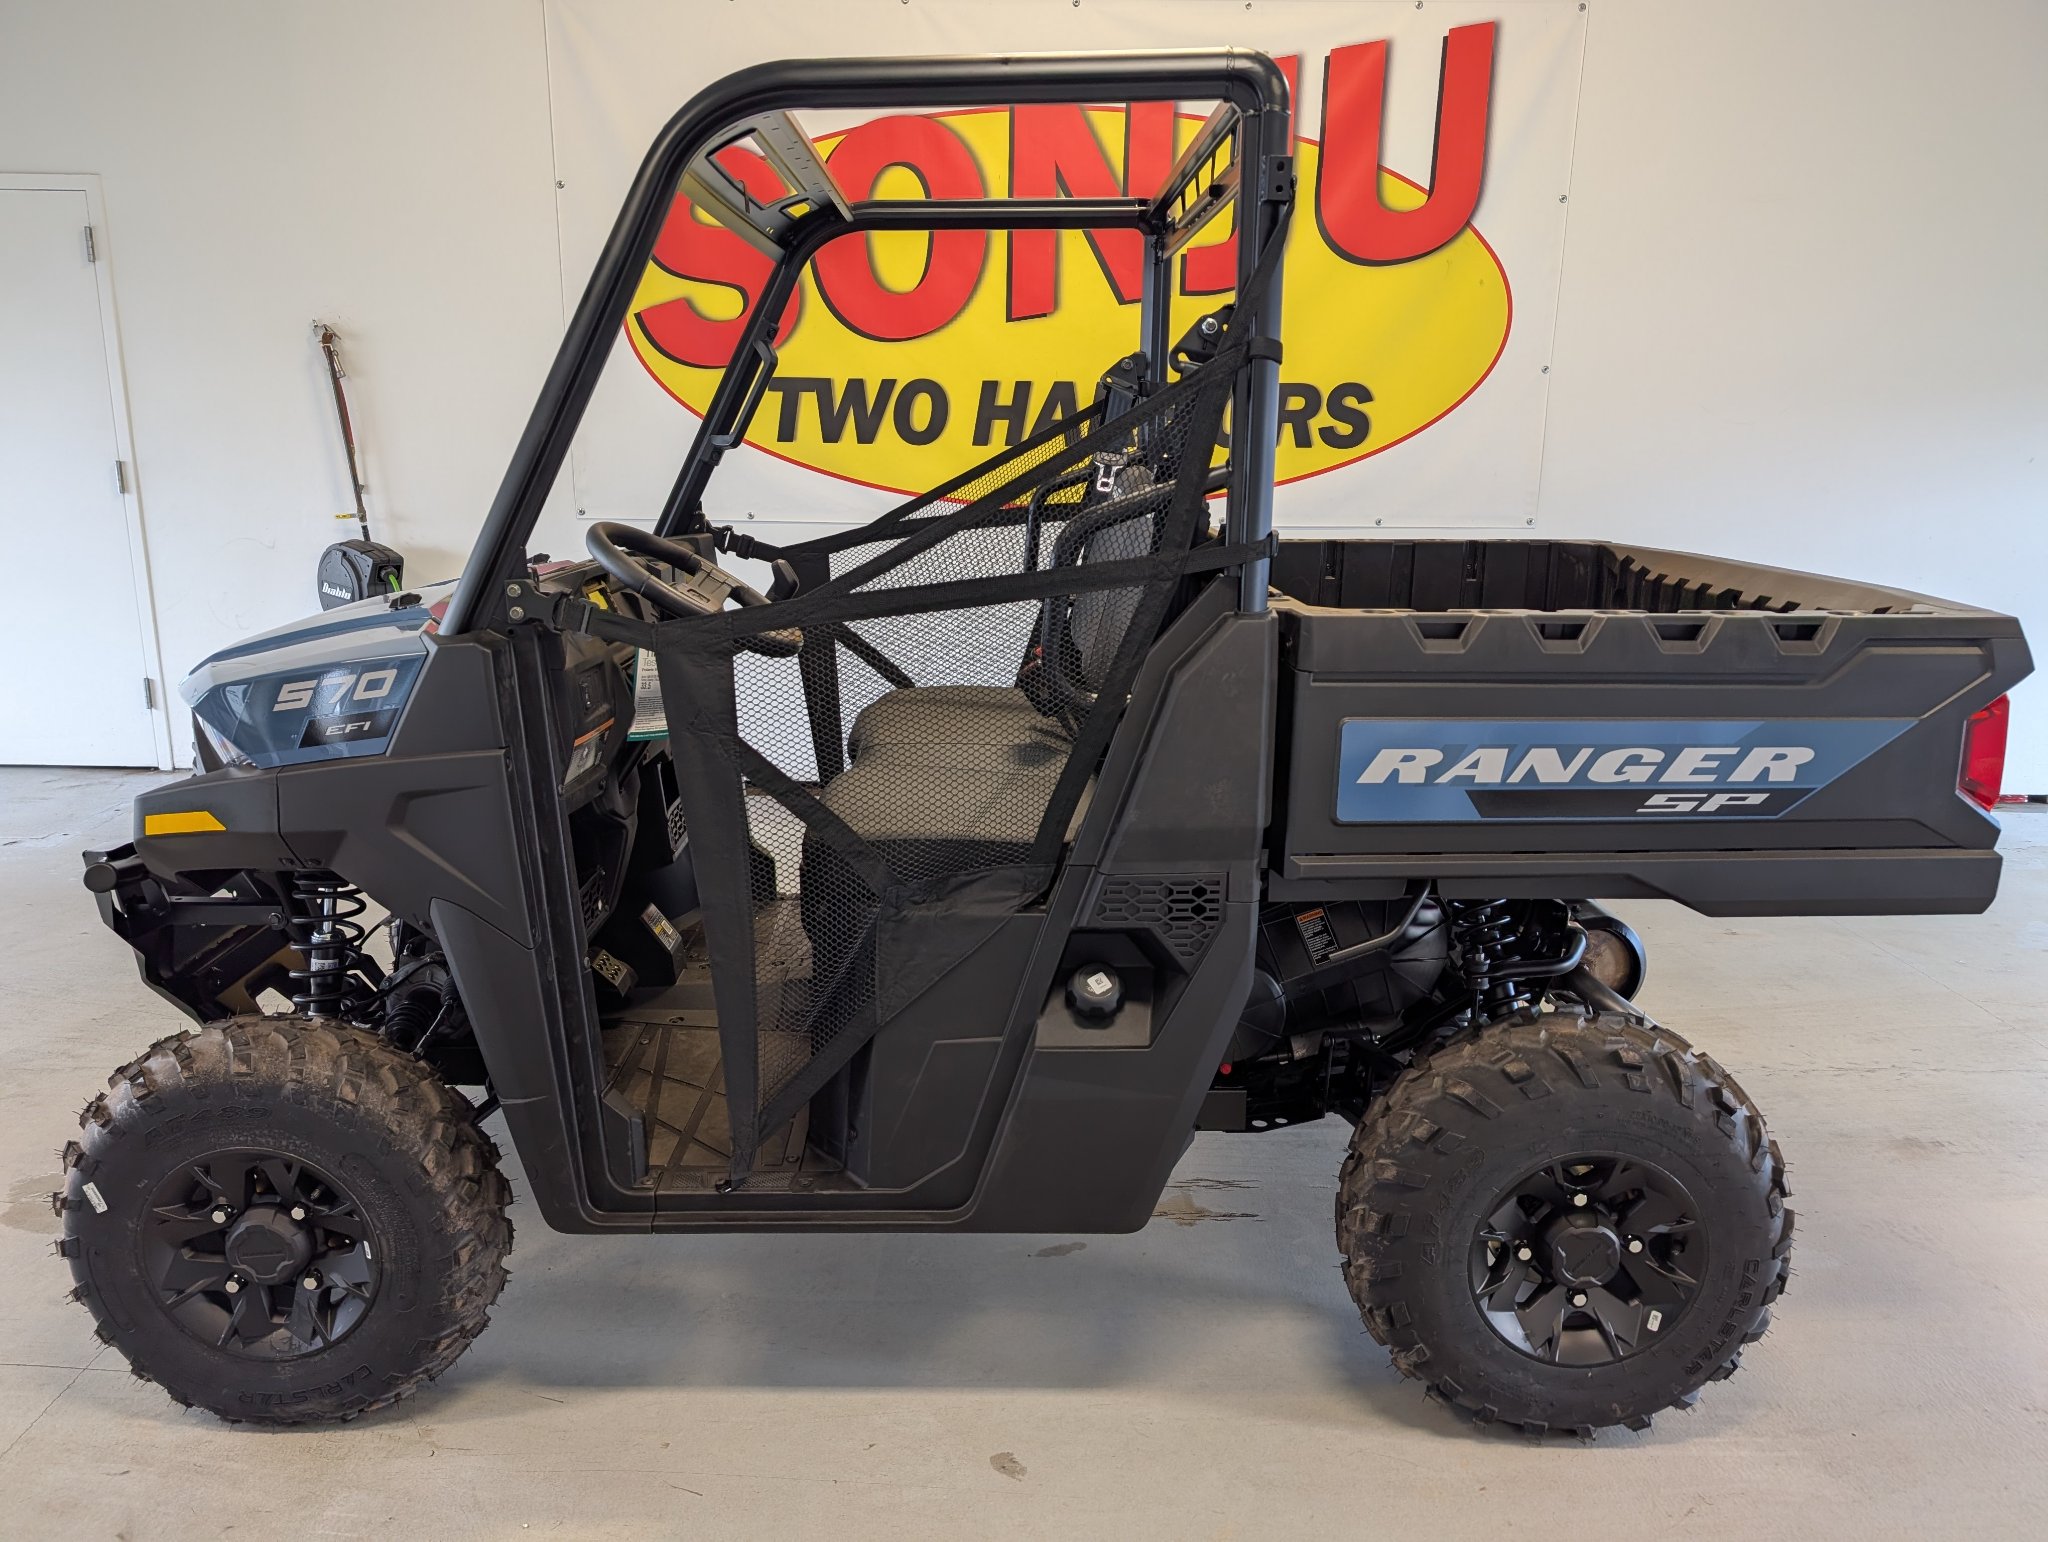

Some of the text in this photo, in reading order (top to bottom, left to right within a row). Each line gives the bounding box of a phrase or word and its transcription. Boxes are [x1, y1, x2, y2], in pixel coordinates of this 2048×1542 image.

[767, 377, 1375, 449] TWO HARS
[322, 582, 351, 600] Diablo
[272, 669, 398, 712] 570
[324, 721, 372, 736] EFI
[1356, 746, 1816, 784] RANGER
[1636, 793, 1771, 812] SP
